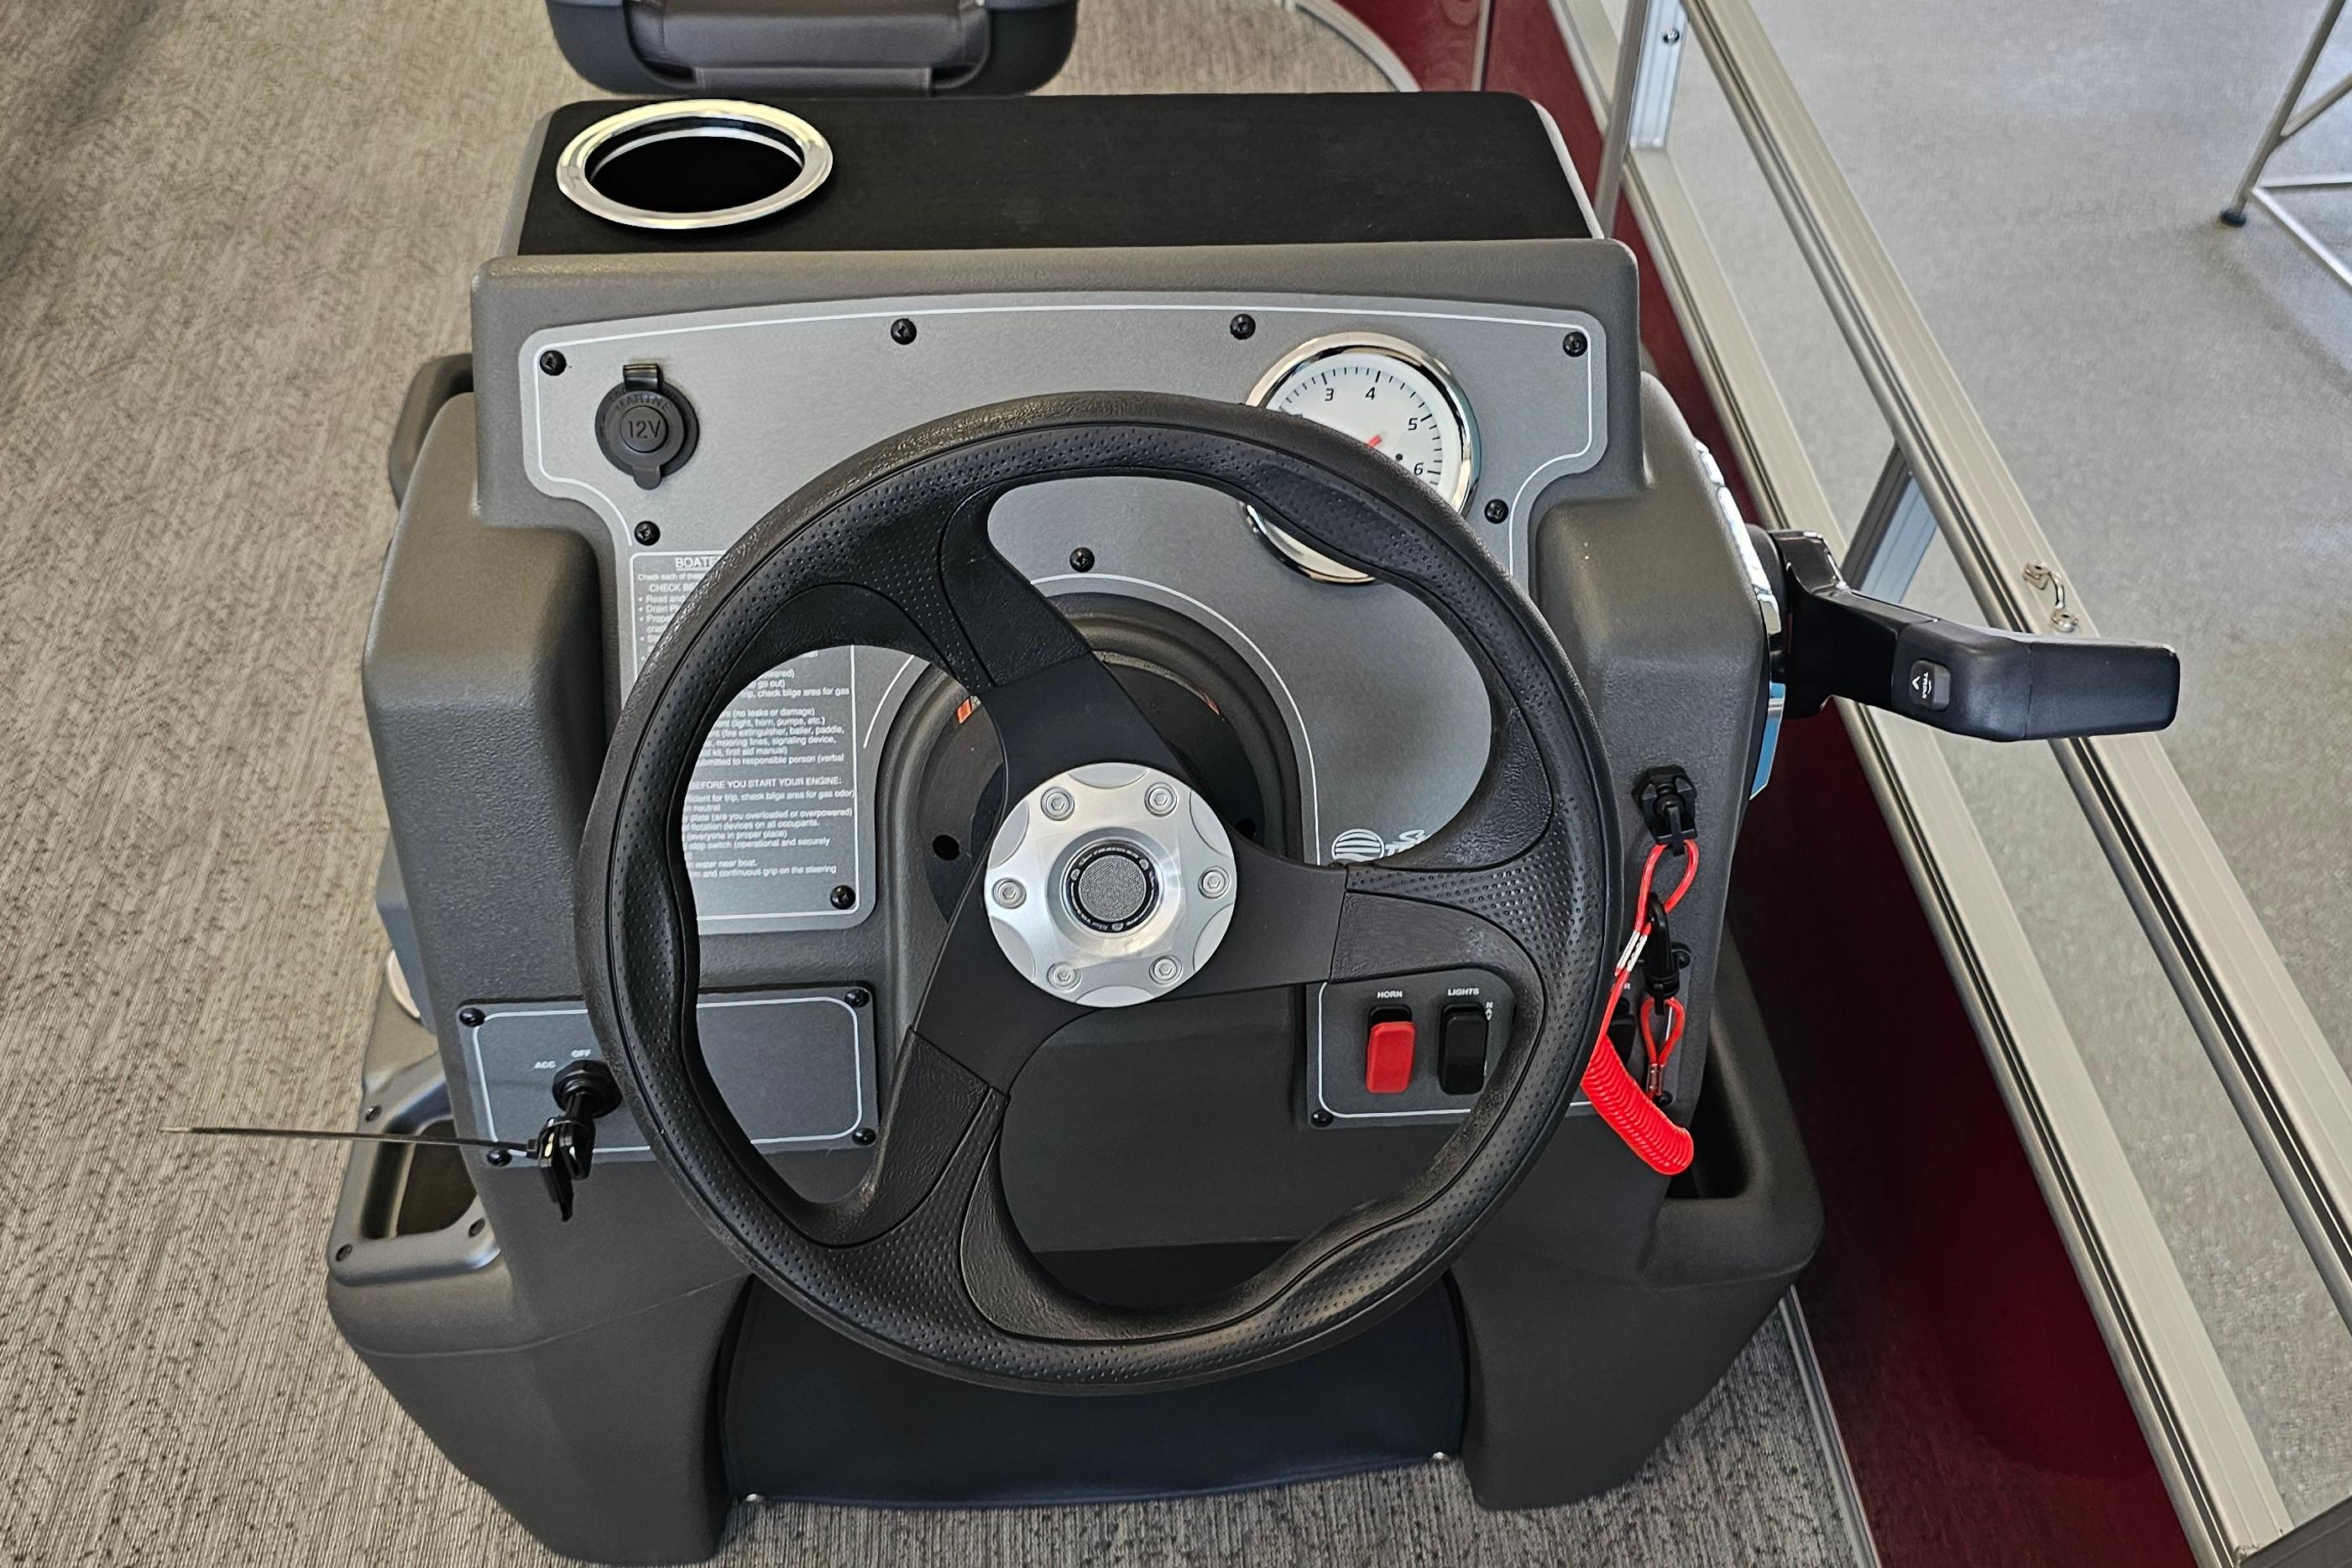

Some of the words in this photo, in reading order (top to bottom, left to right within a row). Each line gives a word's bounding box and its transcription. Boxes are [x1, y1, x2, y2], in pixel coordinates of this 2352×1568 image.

[1325, 389, 1335, 401] 3
[1365, 387, 1376, 400] 4
[629, 420, 661, 438] 12V
[1408, 418, 1418, 431] 5
[1414, 463, 1424, 475] 6
[650, 583, 682, 593] CHECK
[757, 688, 781, 698] check
[782, 688, 802, 698] bilge
[823, 687, 834, 696] for
[834, 687, 849, 697] gas
[748, 708, 769, 717] leaks
[780, 707, 815, 717] damage)
[755, 718, 776, 727] horn,
[808, 735, 837, 744] device,
[742, 746, 755, 755] aid
[732, 757, 740, 766] to
[742, 756, 787, 766] responsible
[788, 755, 816, 765] person
[727, 780, 746, 789] YOU
[748, 778, 777, 788] START
[778, 777, 805, 787] YOUR
[806, 776, 842, 787] ENGINE:
[712, 794, 723, 802] for
[740, 792, 765, 801] check
[766, 792, 785, 802] bilge
[787, 792, 805, 800] area
[806, 790, 818, 798] for
[818, 791, 833, 800] gas
[834, 789, 855, 798] odor)
[729, 813, 744, 822] you
[745, 809, 789, 819] overloaded
[790, 810, 798, 818] or
[799, 808, 853, 818] overpowered)
[724, 821, 754, 831] devices
[755, 822, 766, 830] on
[736, 831, 761, 840] proper
[762, 829, 787, 839] place)
[781, 838, 796, 847] and
[702, 870, 717, 878] and
[719, 868, 762, 878] continuous
[791, 865, 804, 875] the
[805, 865, 837, 875] steering
[1377, 990, 1403, 999] HORN
[1447, 987, 1480, 996] LIGHTS
[571, 1048, 592, 1058] OFF
[534, 1060, 557, 1069] ACC
